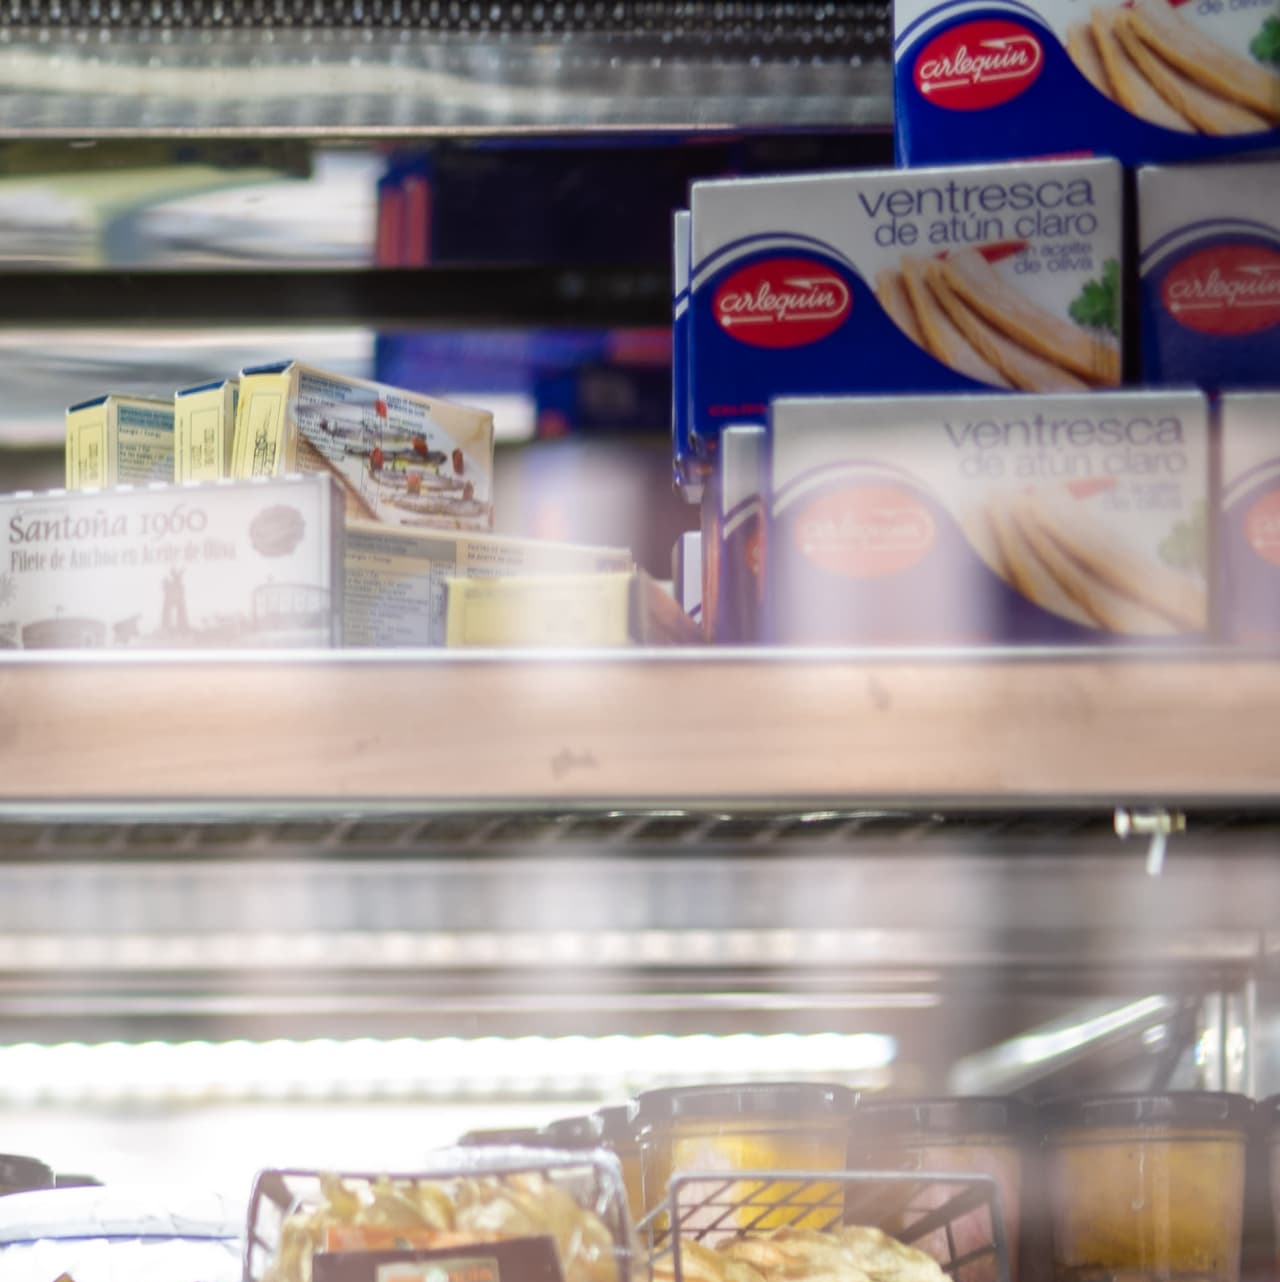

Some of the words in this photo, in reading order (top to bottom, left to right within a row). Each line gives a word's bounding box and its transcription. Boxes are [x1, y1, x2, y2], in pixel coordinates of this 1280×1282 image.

[858, 178, 1095, 219] ventresca
[874, 215, 918, 248] de
[928, 211, 1003, 243] atún
[1021, 207, 1098, 238] claro
[945, 414, 1185, 451] ventresca
[1104, 442, 1189, 475] claro
[8, 507, 128, 546] Santoña
[137, 504, 209, 540] 1960
[10, 548, 47, 573] Filete
[51, 549, 67, 570] de
